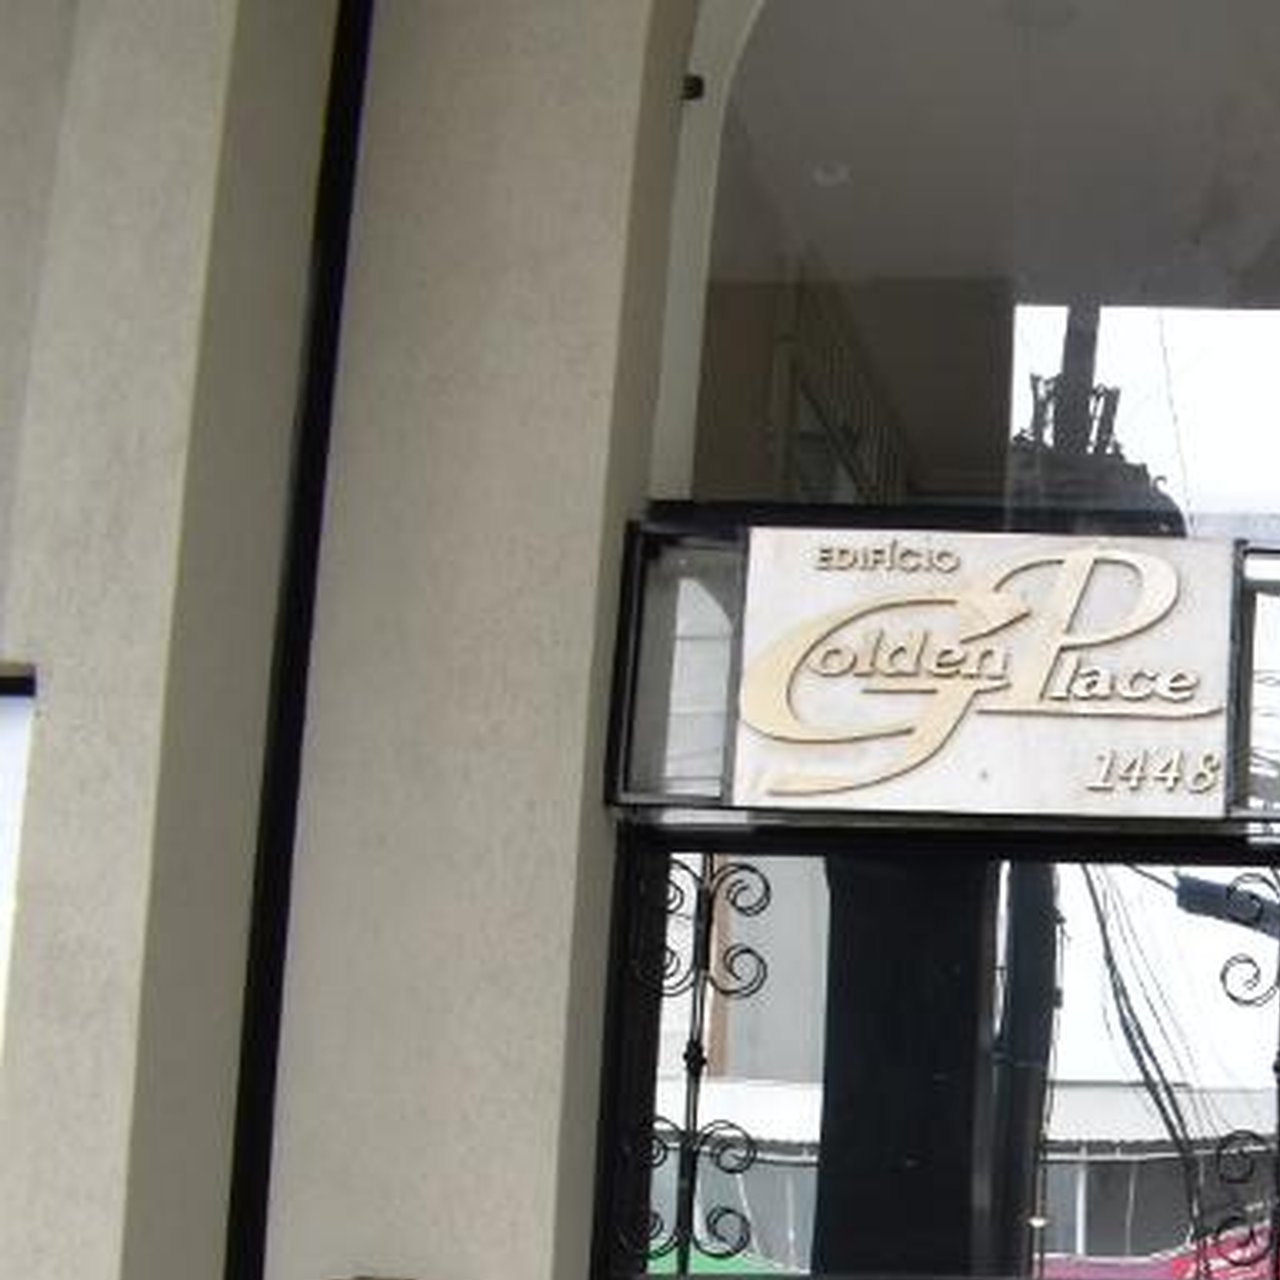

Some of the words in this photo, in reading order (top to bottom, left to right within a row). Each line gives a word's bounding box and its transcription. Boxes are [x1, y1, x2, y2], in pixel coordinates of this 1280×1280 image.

[814, 538, 961, 573] EDIFÍCIO
[738, 580, 1032, 797] Golden
[993, 546, 1224, 720] Place
[1085, 748, 1223, 795] 1448
